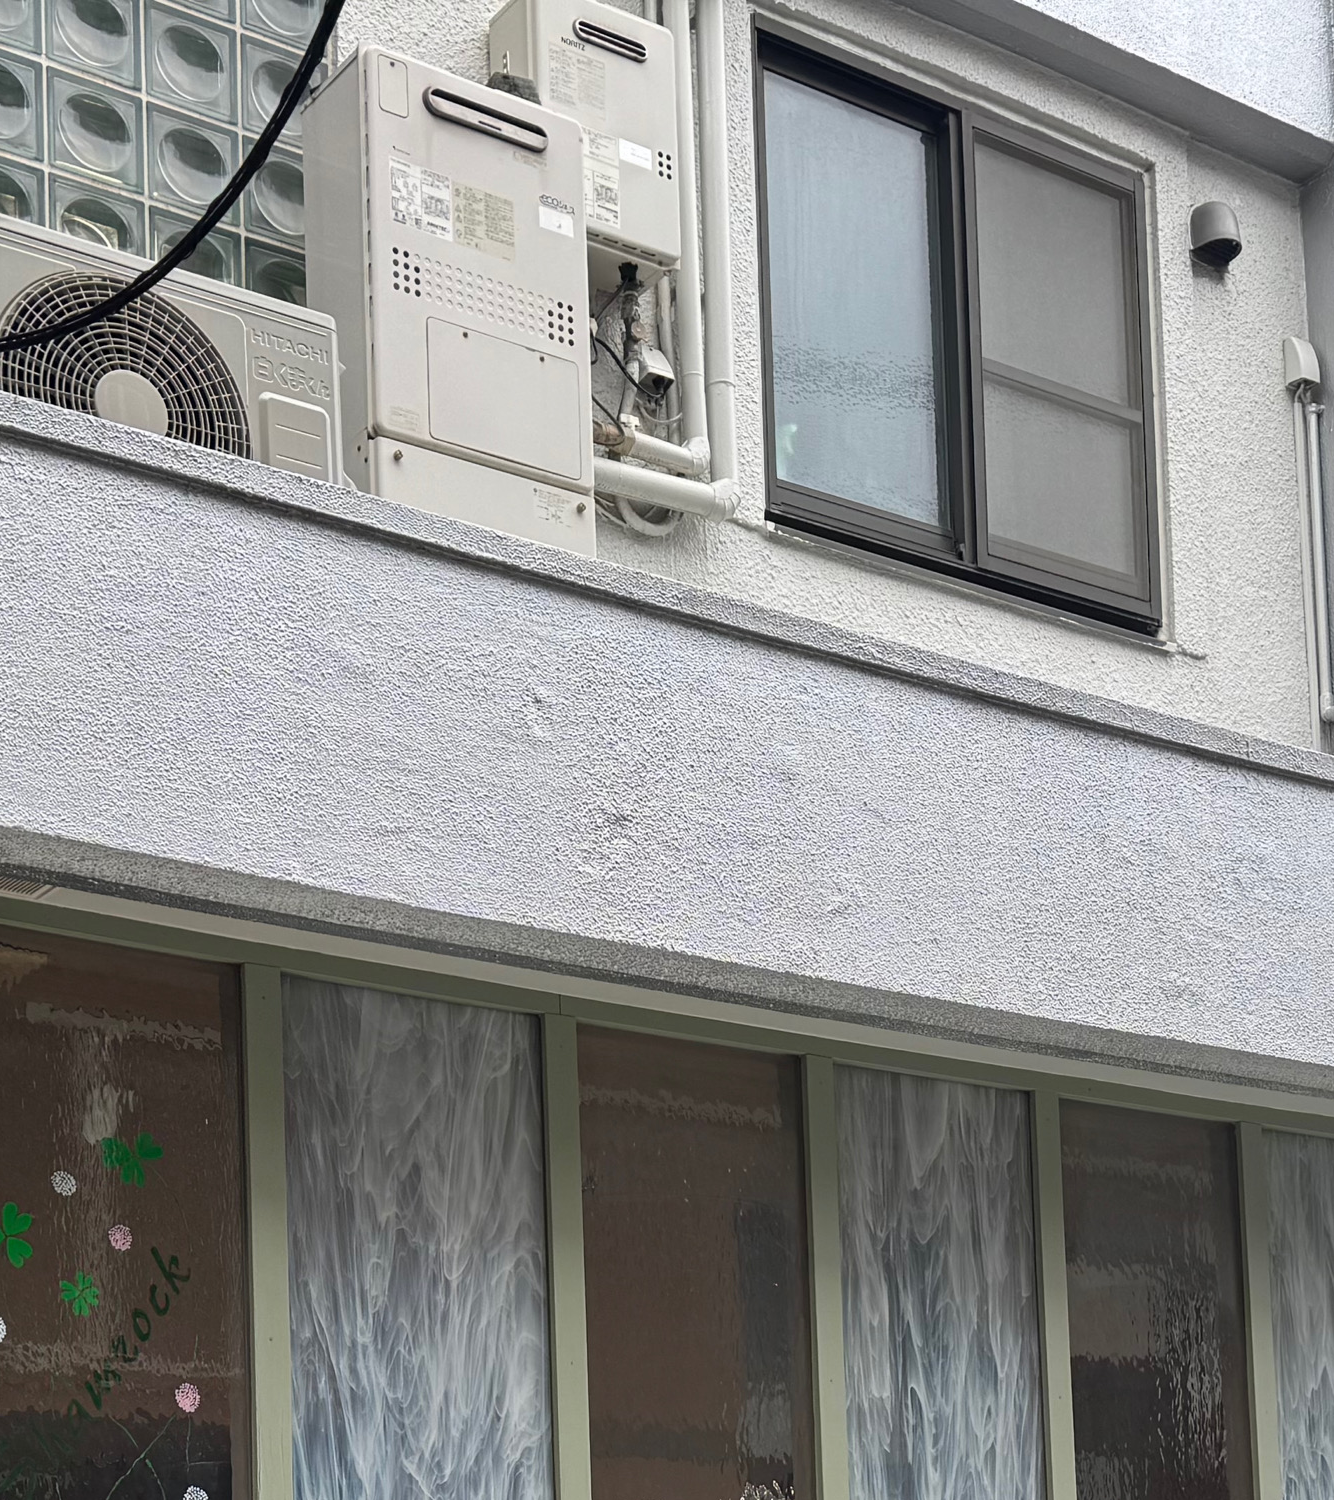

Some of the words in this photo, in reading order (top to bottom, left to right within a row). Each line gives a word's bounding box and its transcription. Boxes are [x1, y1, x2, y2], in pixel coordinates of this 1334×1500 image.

[561, 36, 585, 51] NORITZ
[250, 328, 329, 365] HITACHI
[252, 356, 331, 401] 白くまくん
